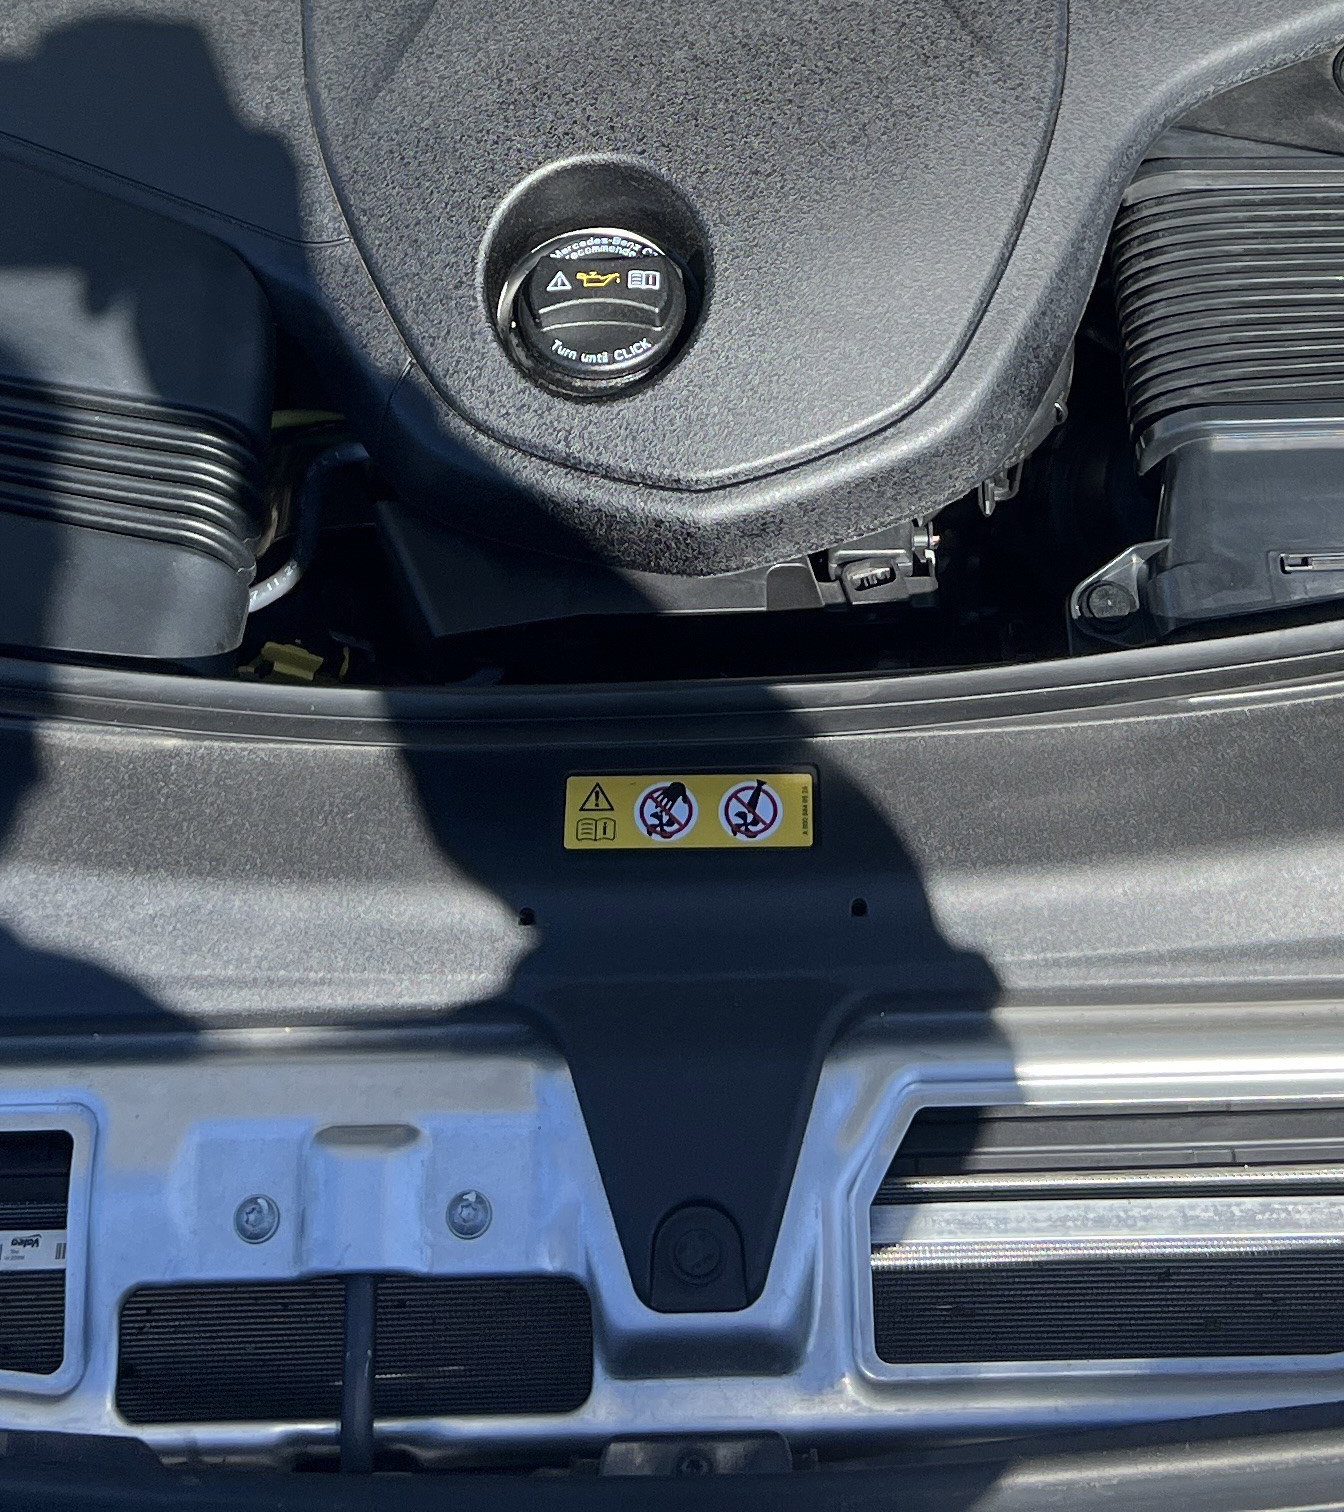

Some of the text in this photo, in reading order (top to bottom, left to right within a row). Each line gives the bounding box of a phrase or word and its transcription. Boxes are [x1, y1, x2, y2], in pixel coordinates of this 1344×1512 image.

[551, 338, 652, 363] Turn until CLICK
